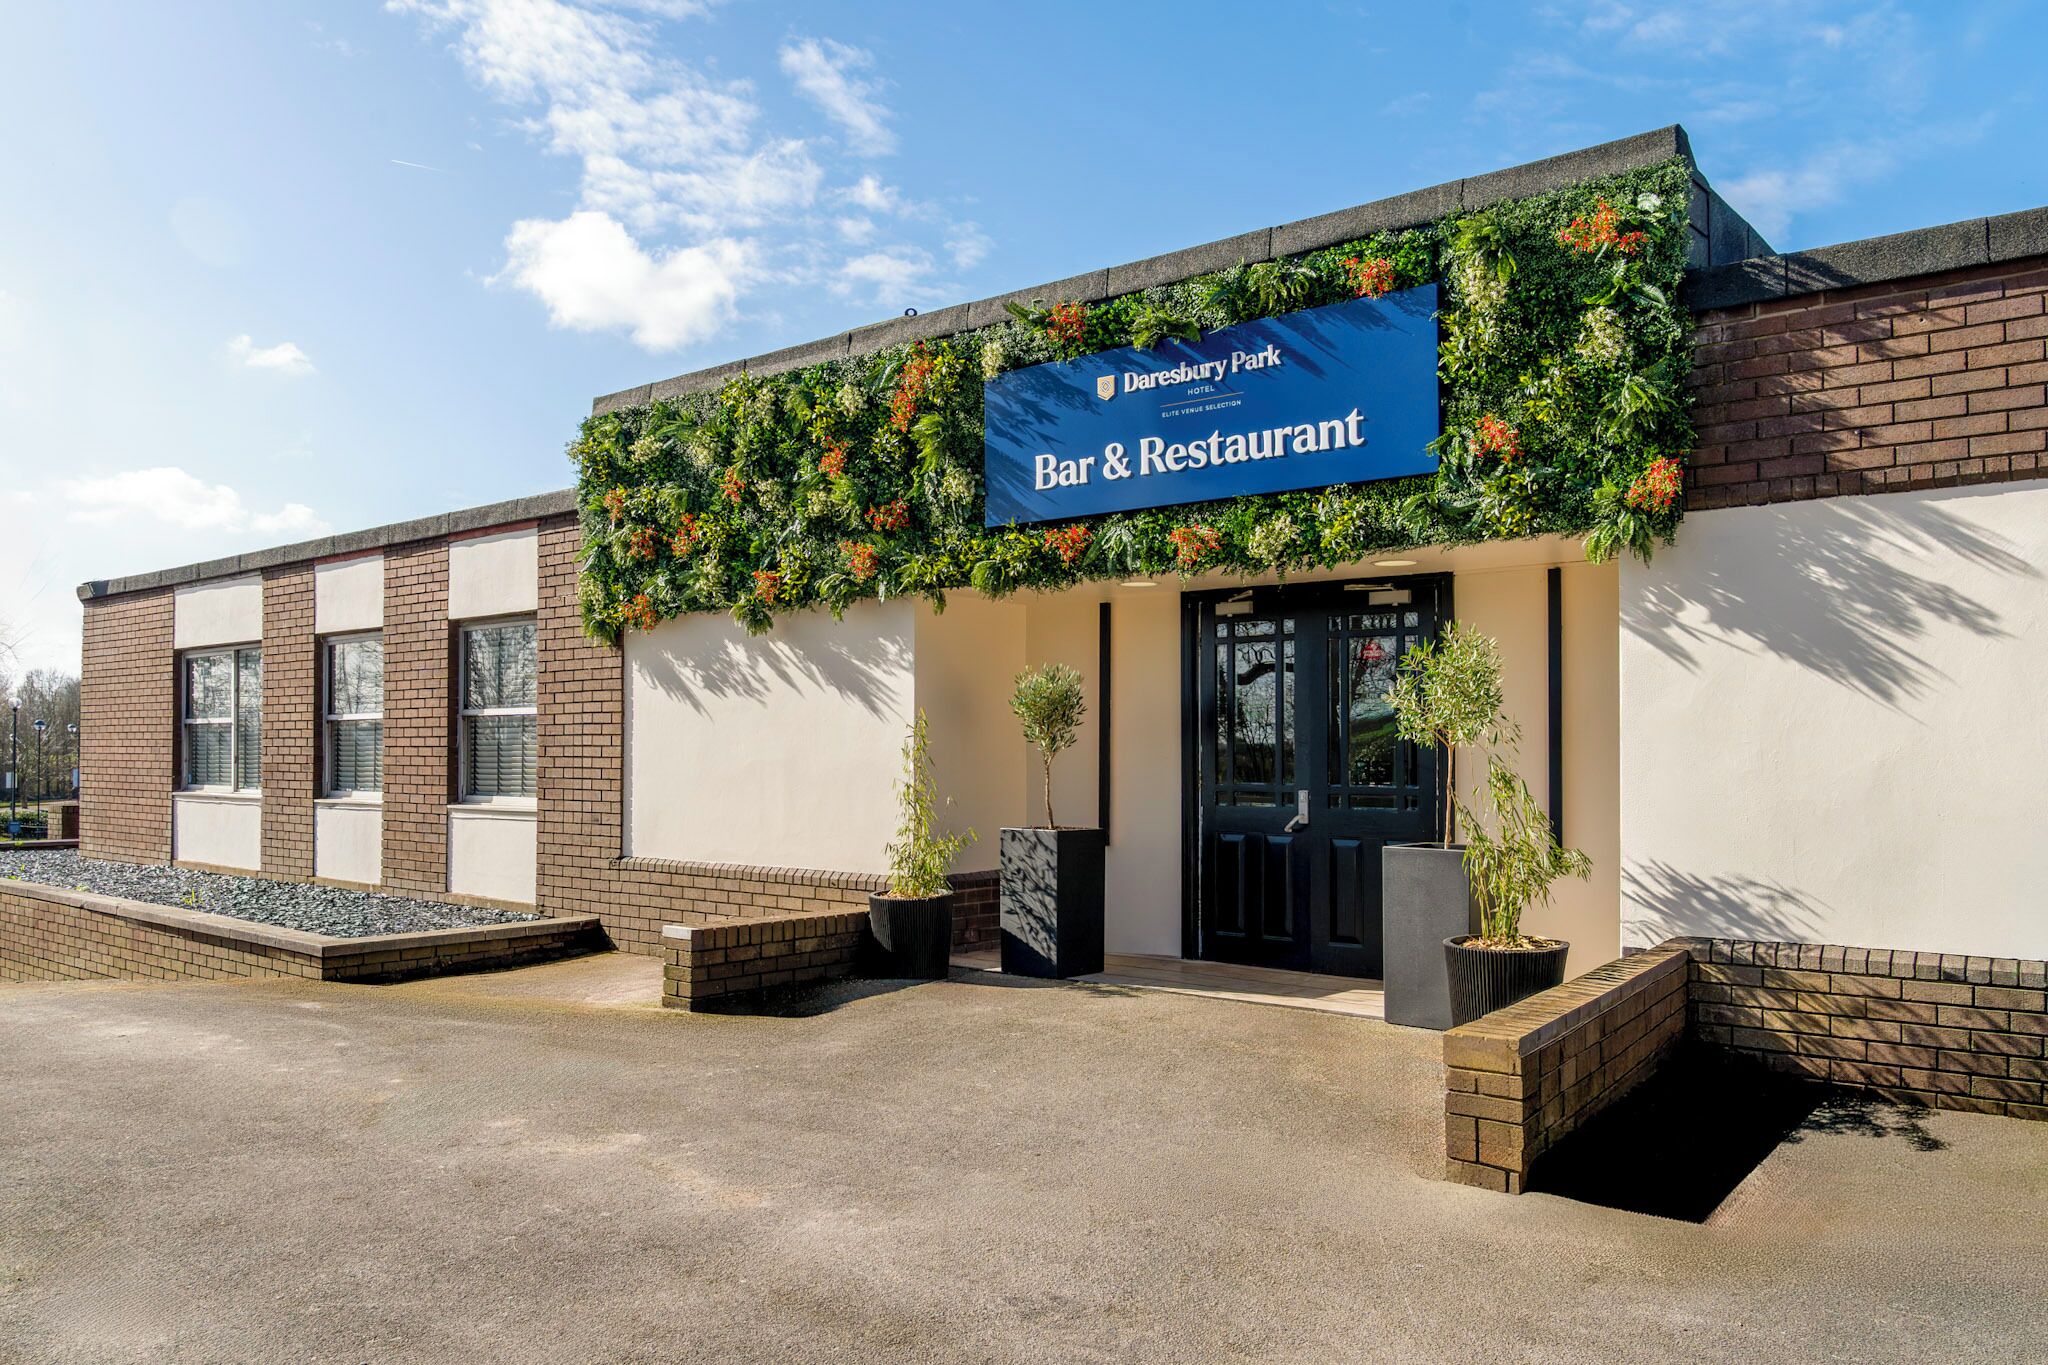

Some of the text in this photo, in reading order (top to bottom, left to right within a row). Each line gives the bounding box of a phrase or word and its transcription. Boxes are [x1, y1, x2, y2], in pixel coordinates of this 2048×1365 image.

[1124, 344, 1282, 392] Daresbury Park
[1187, 385, 1215, 396] HOTEL
[1161, 400, 1242, 418] ELITE VENUE SELECTION
[1035, 408, 1364, 490] Bar & Restaurant
